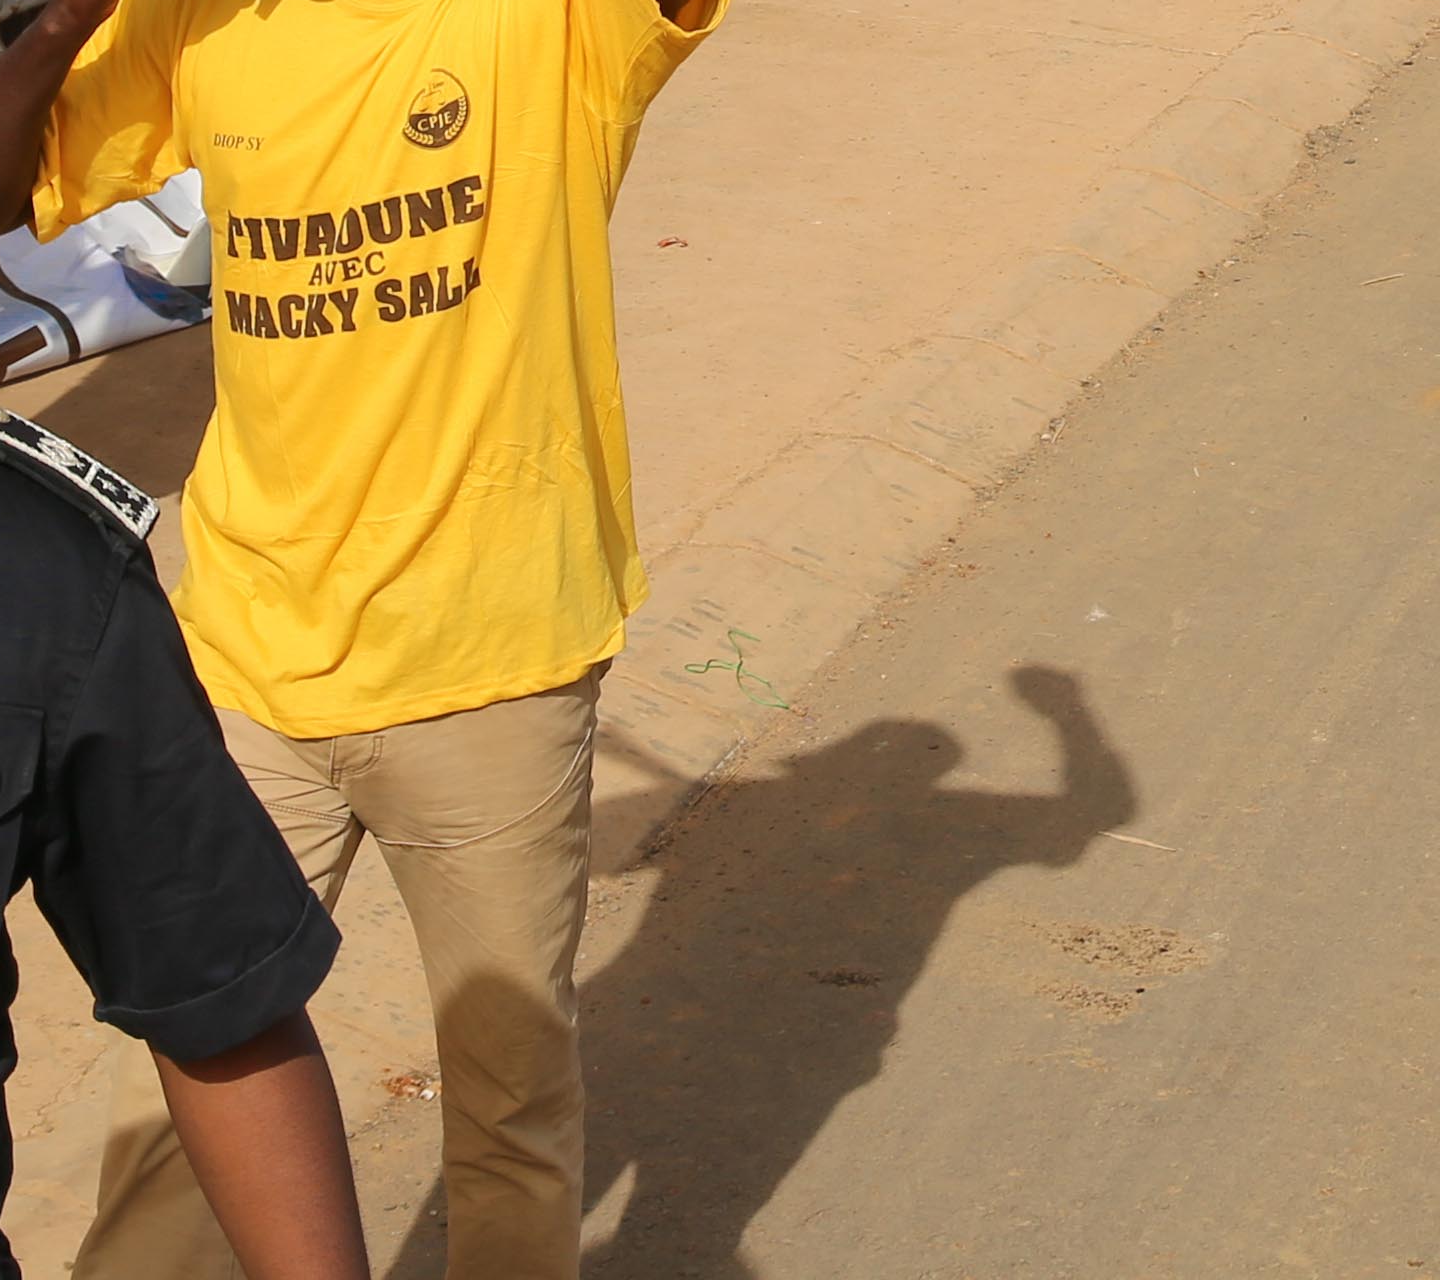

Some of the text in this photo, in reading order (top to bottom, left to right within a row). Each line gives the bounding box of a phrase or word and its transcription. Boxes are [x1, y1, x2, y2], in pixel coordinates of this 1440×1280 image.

[213, 132, 265, 151] DIOP SY
[308, 250, 386, 287] AVEC
[224, 256, 482, 339] MACKY SALL
